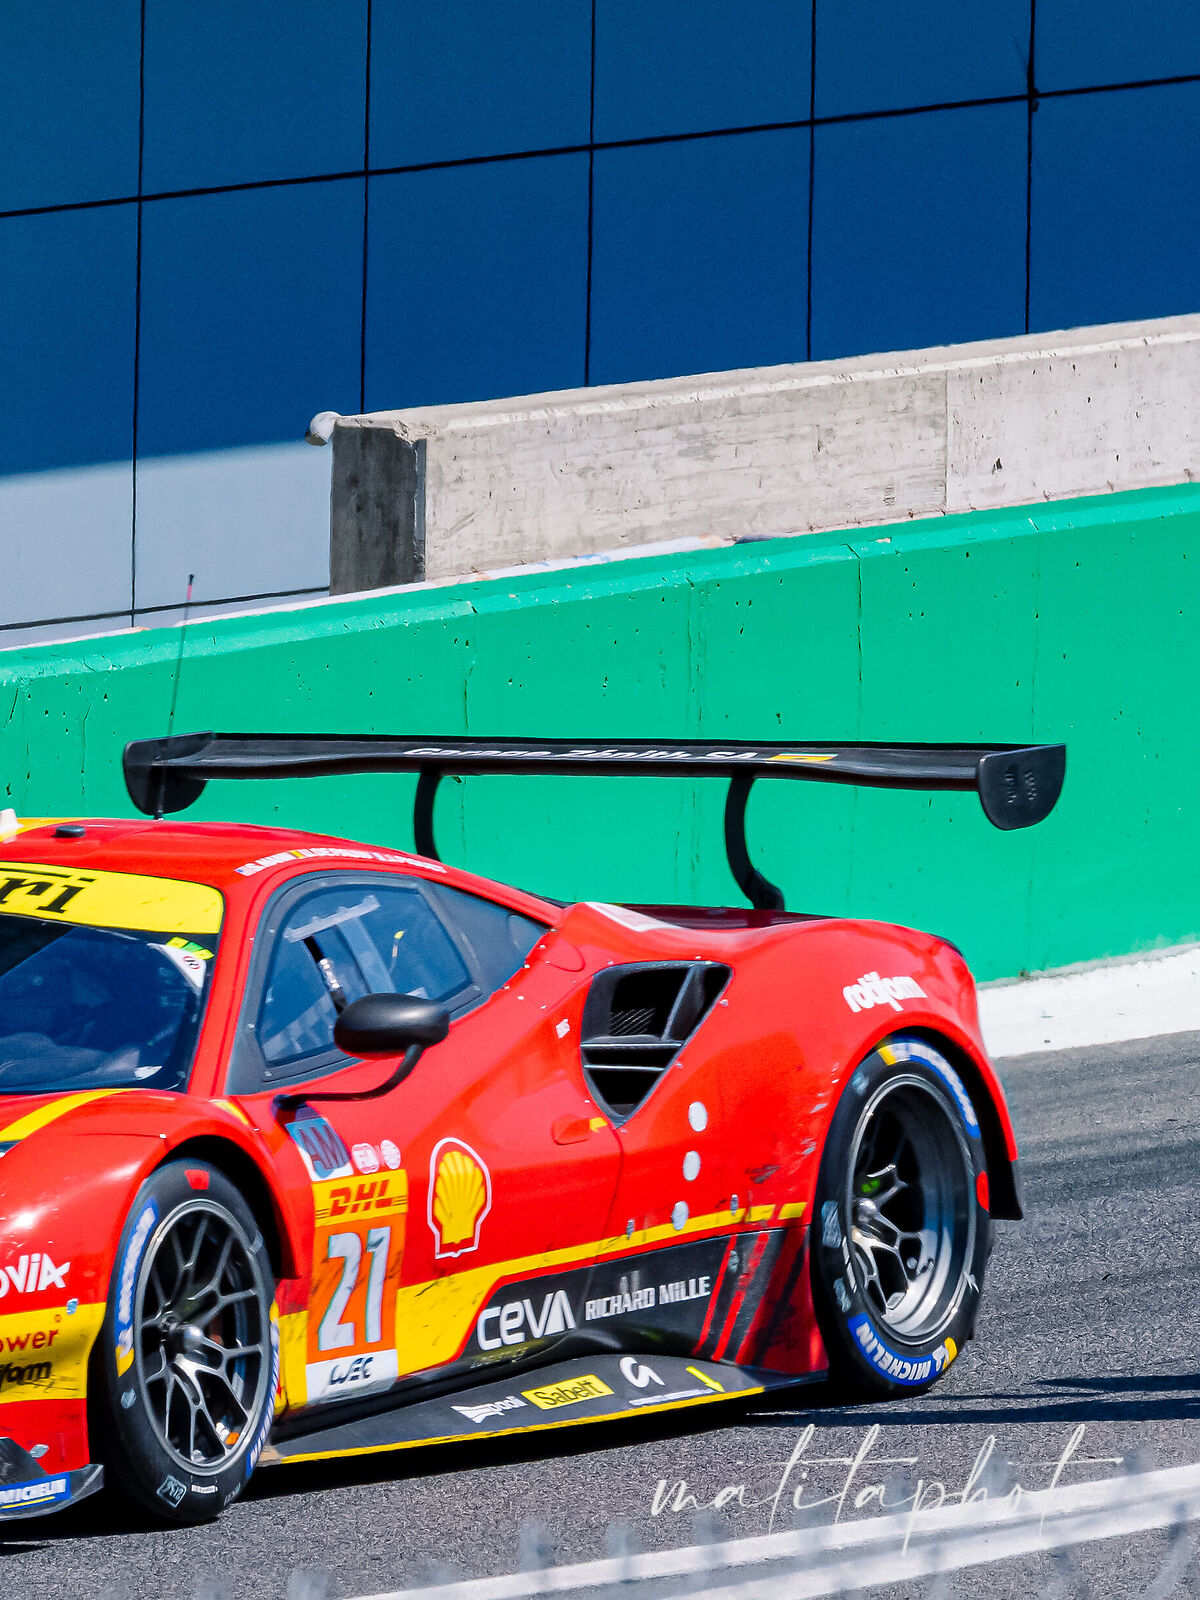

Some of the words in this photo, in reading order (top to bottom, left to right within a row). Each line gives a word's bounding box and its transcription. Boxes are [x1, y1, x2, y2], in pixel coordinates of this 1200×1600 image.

[297, 1124, 349, 1172] AM
[330, 1179, 396, 1217] DHL
[318, 1226, 392, 1351] 21
[585, 1287, 656, 1321] RICHARD
[659, 1276, 711, 1304] MILLE
[329, 1356, 374, 1386] WEC
[855, 1321, 932, 1381] MICHELIN
[533, 1380, 604, 1406] Sabelt
